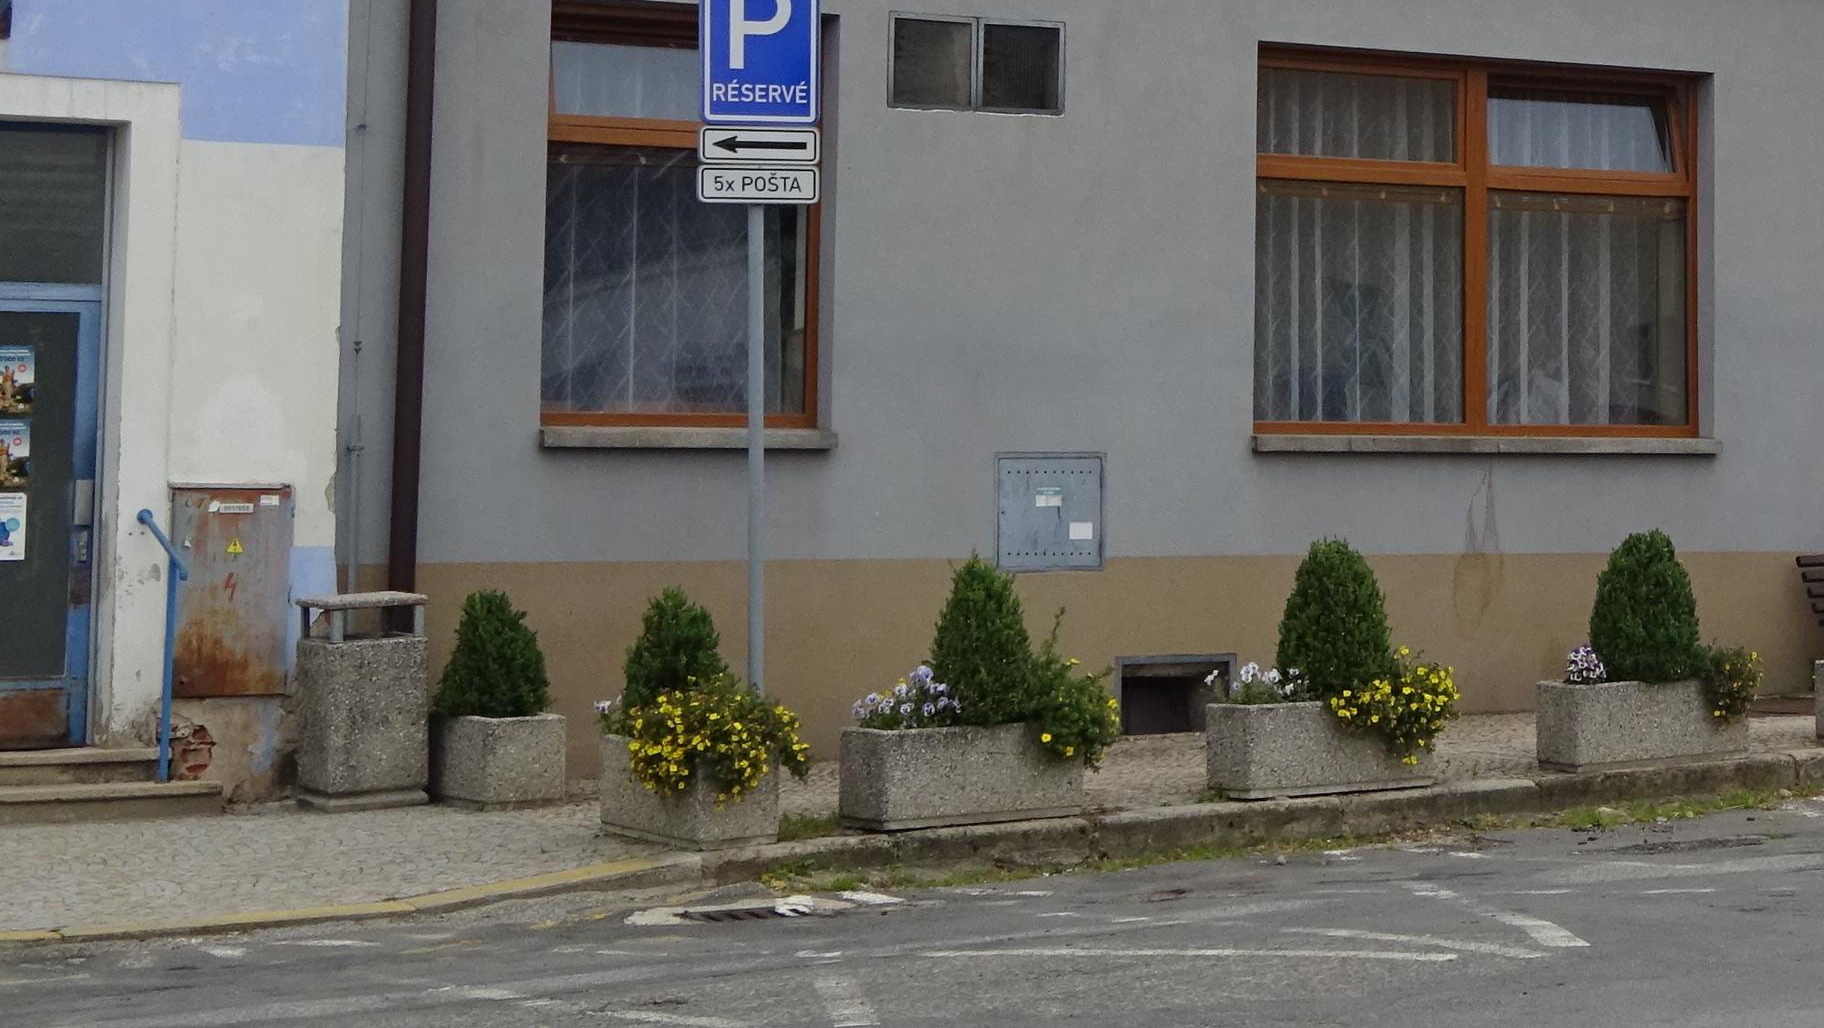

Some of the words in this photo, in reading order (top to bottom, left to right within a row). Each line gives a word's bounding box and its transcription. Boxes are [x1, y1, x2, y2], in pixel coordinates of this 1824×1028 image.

[712, 78, 808, 104] RÉSERVÉ
[714, 175, 735, 192] 5x
[741, 172, 802, 193] POŠTA
